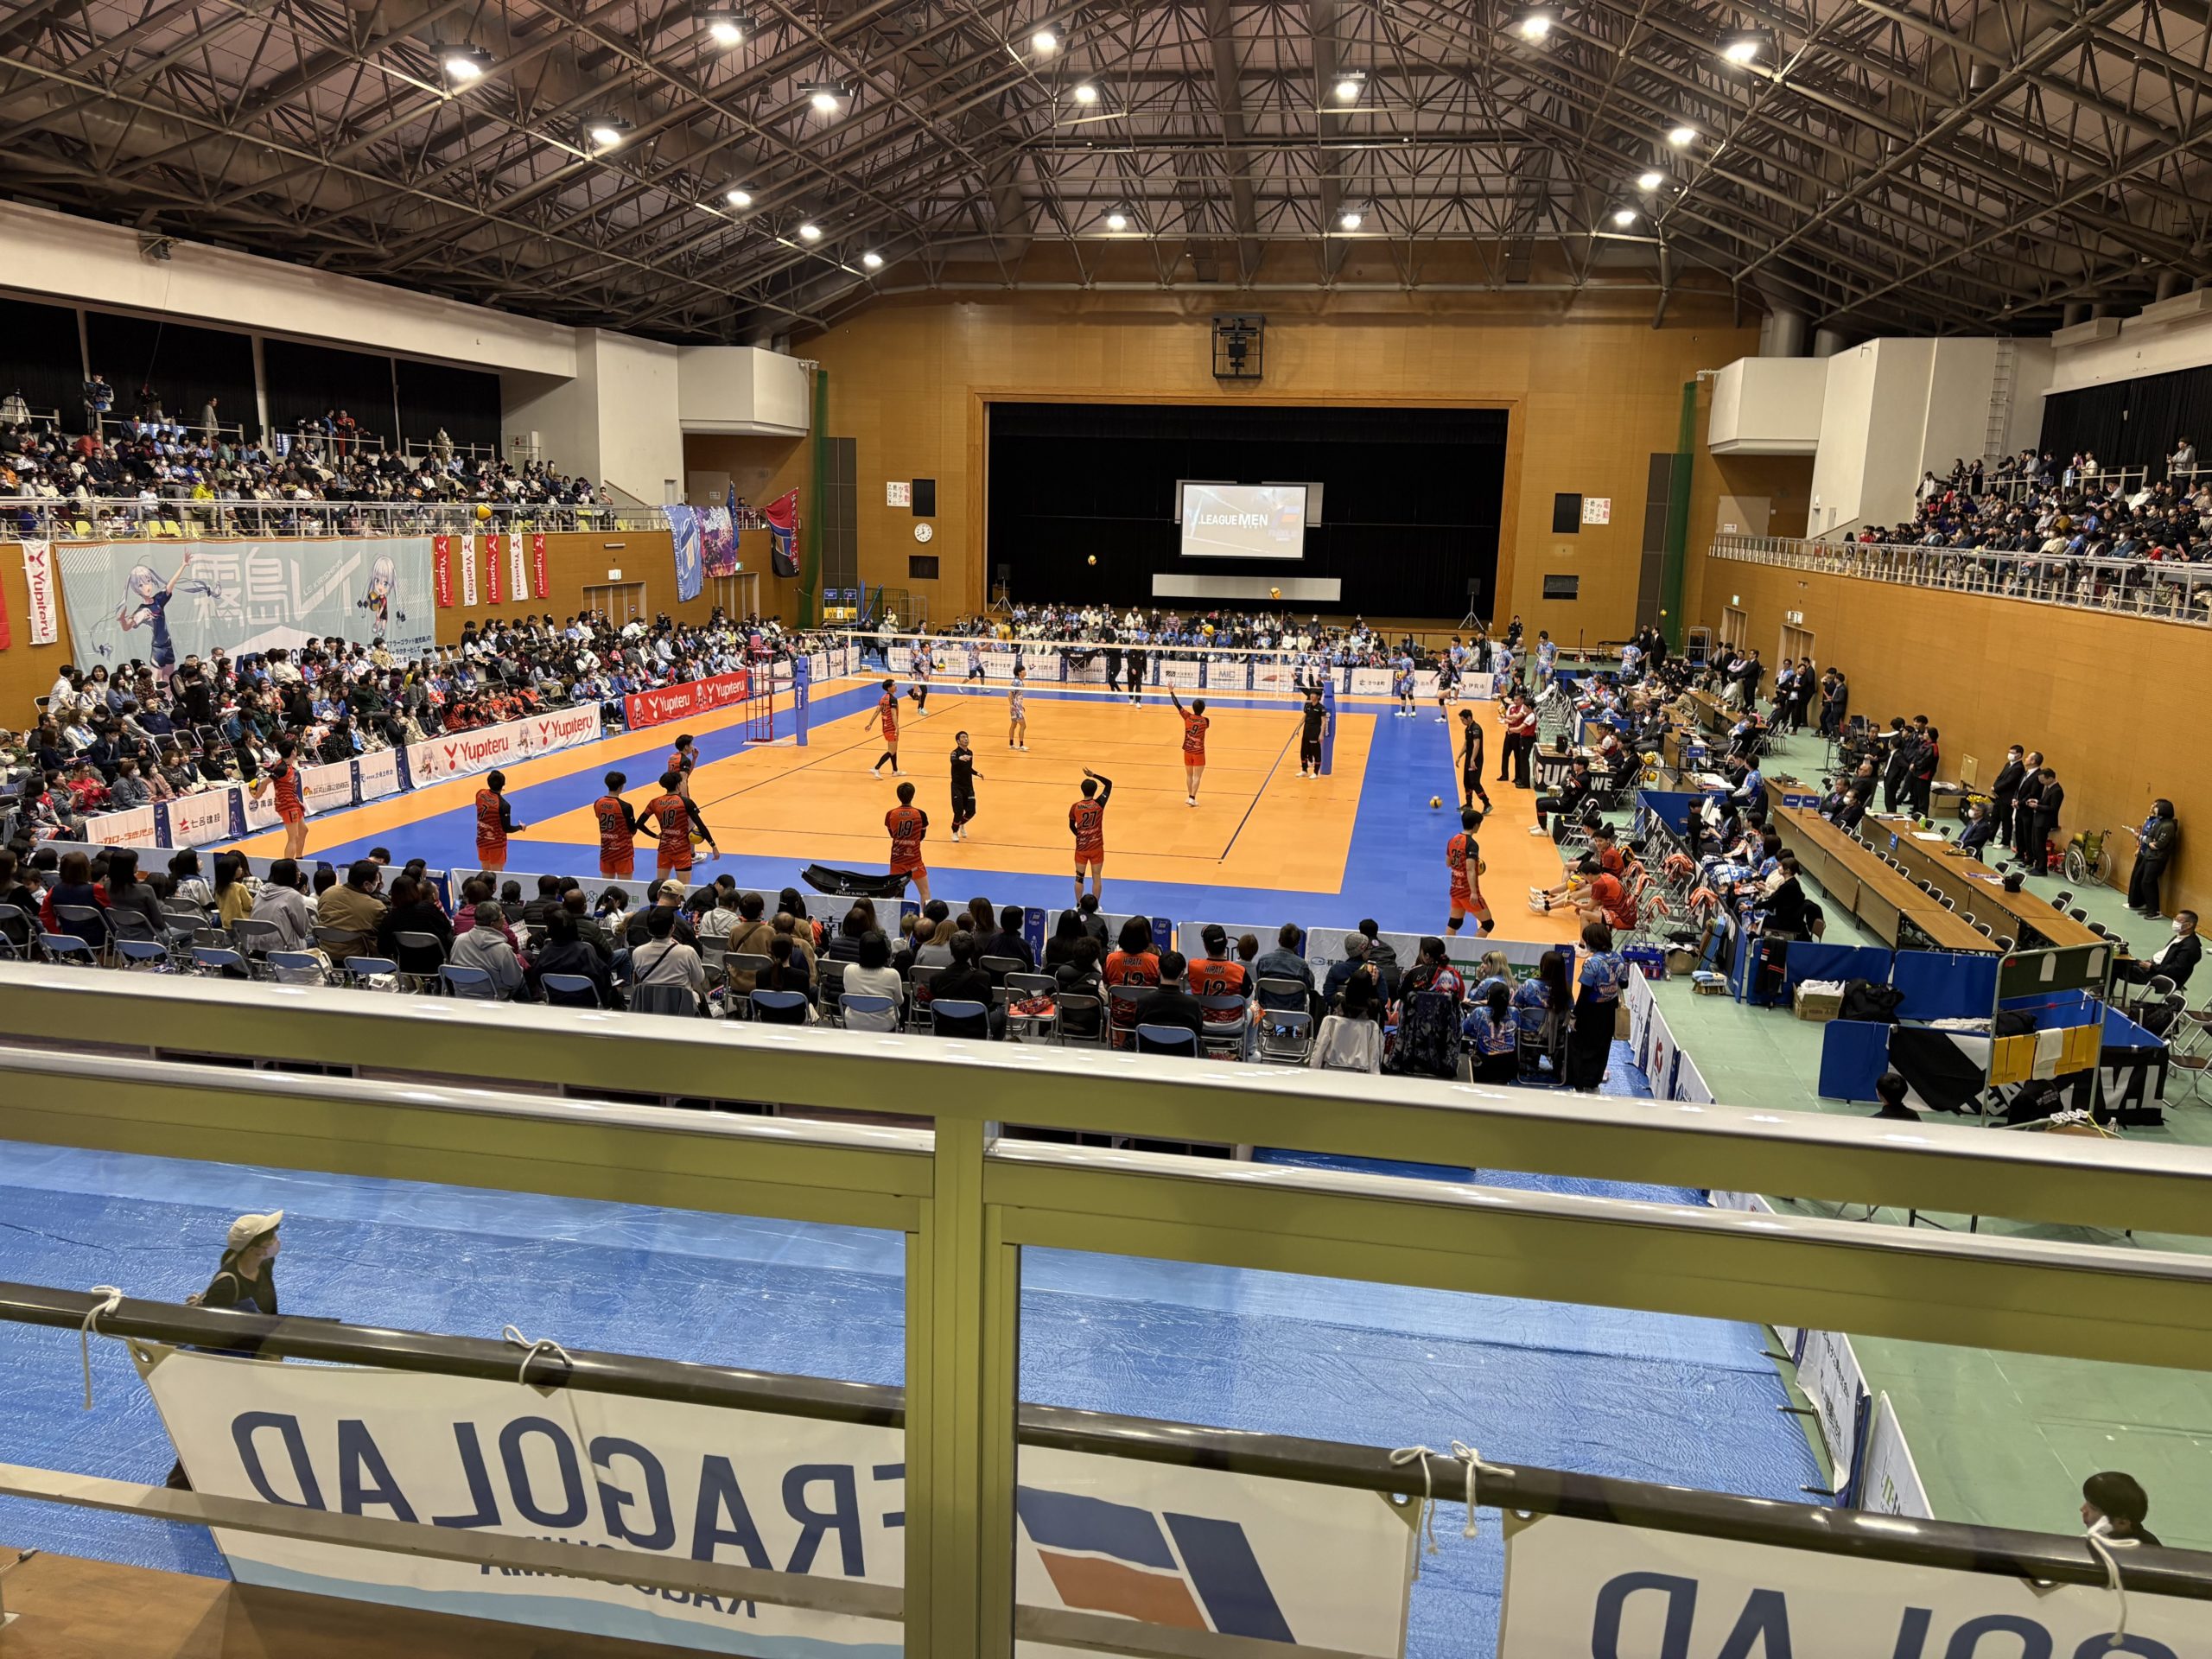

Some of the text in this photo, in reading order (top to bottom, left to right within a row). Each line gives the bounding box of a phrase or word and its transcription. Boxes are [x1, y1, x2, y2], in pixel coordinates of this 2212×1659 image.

[1238, 513, 1268, 526] MEN
[439, 555, 448, 602] Yupiteru
[465, 554, 474, 601] Yupiteru
[32, 570, 50, 637] Yupiteru
[715, 679, 746, 699] Yupiteru
[659, 691, 690, 715] Yupiteru
[551, 715, 594, 740] Yupiteru
[1192, 723, 1200, 735] 9
[459, 736, 510, 763] Yupiteru
[600, 812, 615, 831] 26
[662, 809, 677, 828] 18
[897, 819, 913, 837] 19
[1082, 810, 1098, 829] 27
[1122, 957, 1142, 966] HIRATA
[1205, 964, 1226, 975] HIRATA
